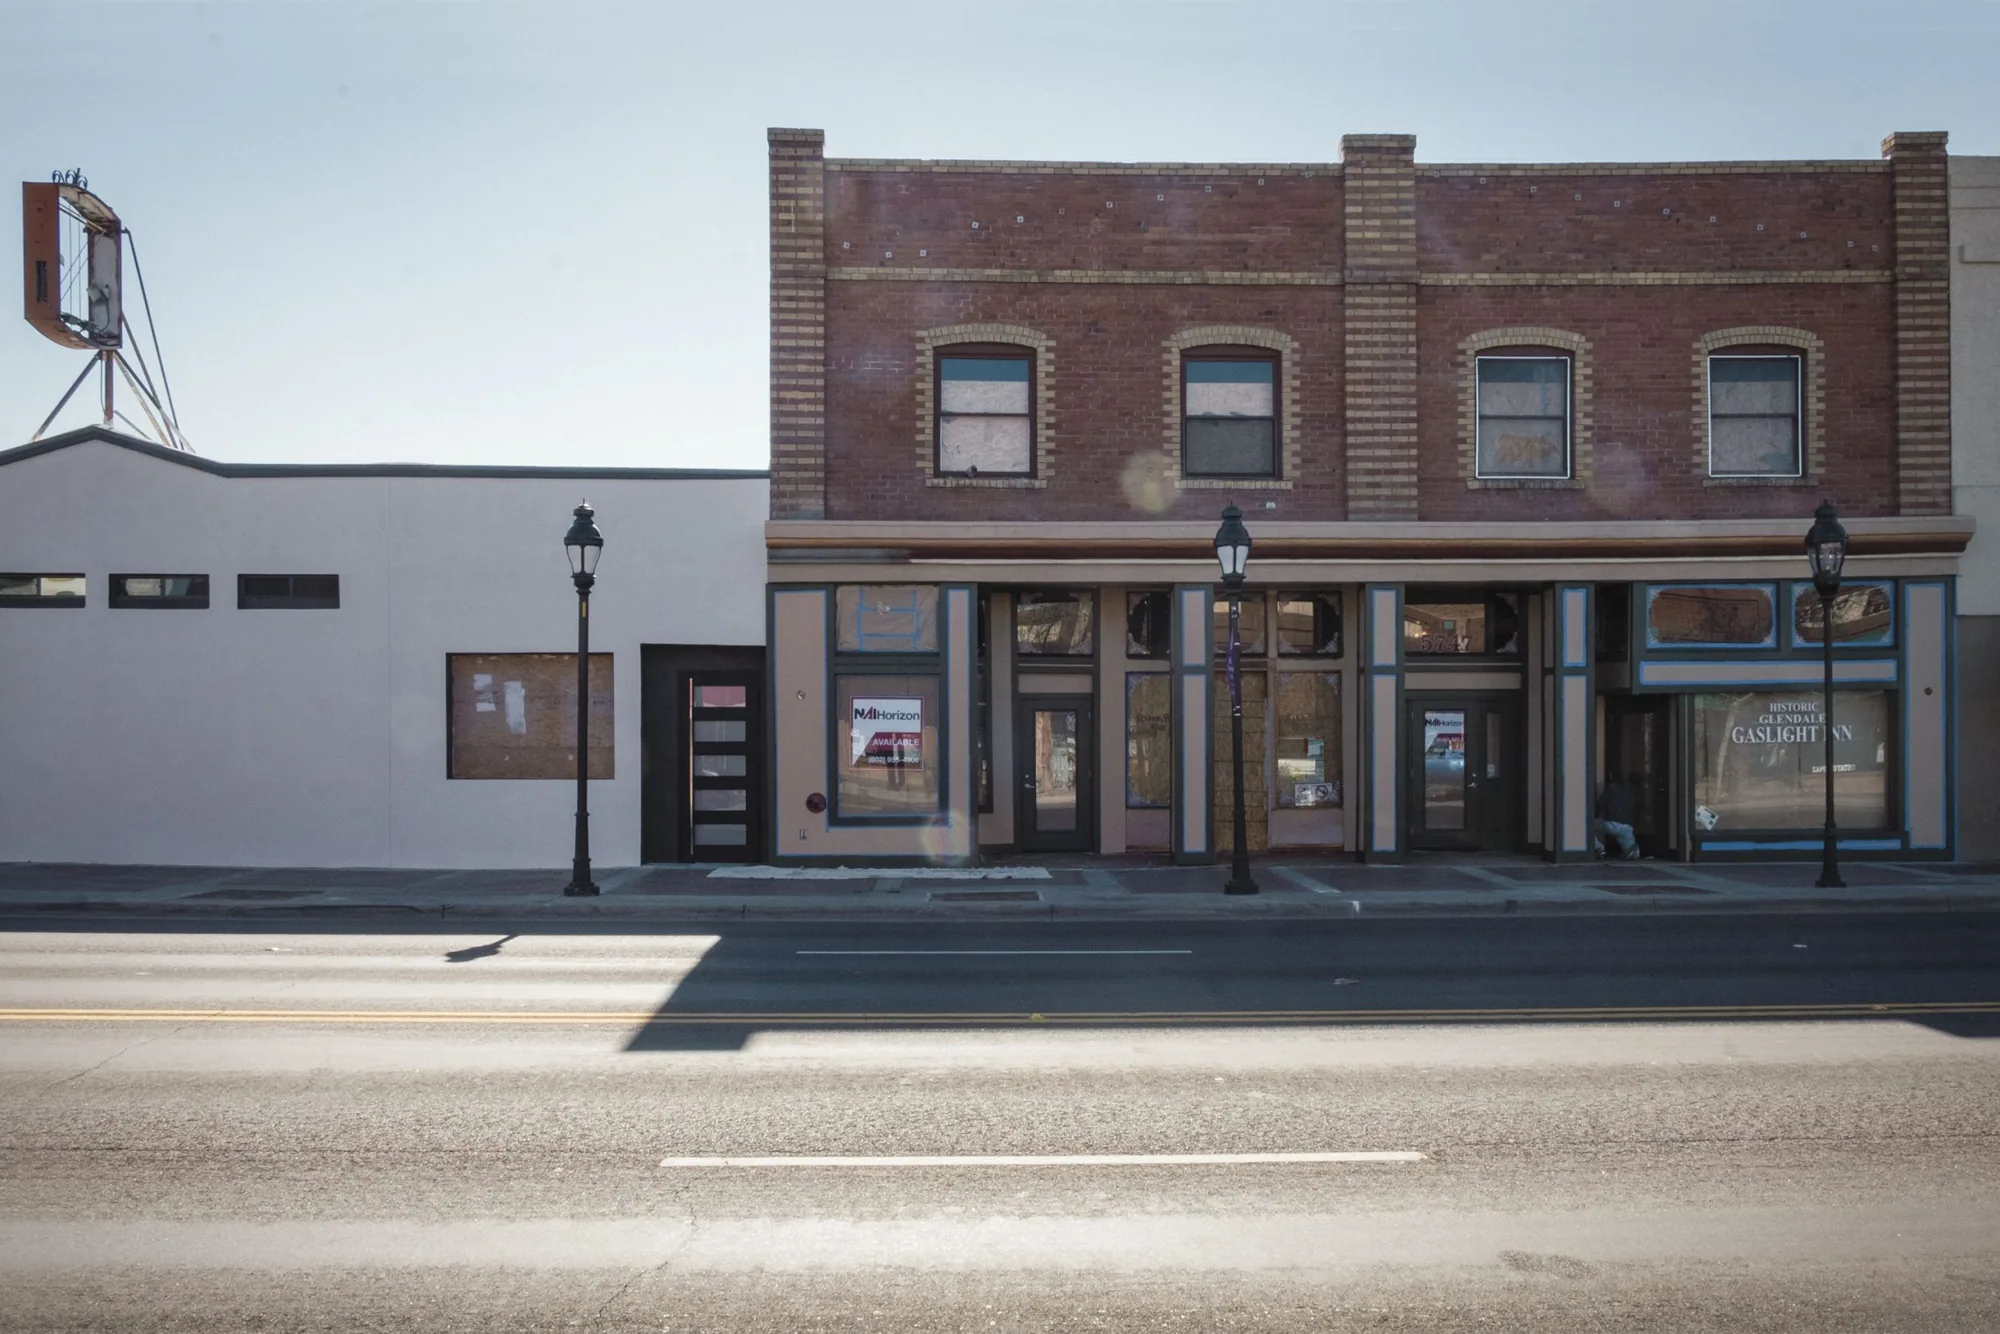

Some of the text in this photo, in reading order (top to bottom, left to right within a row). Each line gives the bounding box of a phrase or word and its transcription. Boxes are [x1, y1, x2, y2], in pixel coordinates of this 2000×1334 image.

[1421, 634, 1473, 652] 5747
[1769, 702, 1819, 712] HISTORIC
[1759, 713, 1826, 724] GLENDALE
[1731, 725, 1818, 743] GASLIGHT
[872, 738, 920, 746] AVAILABLE
[868, 756, 886, 764] (602)
